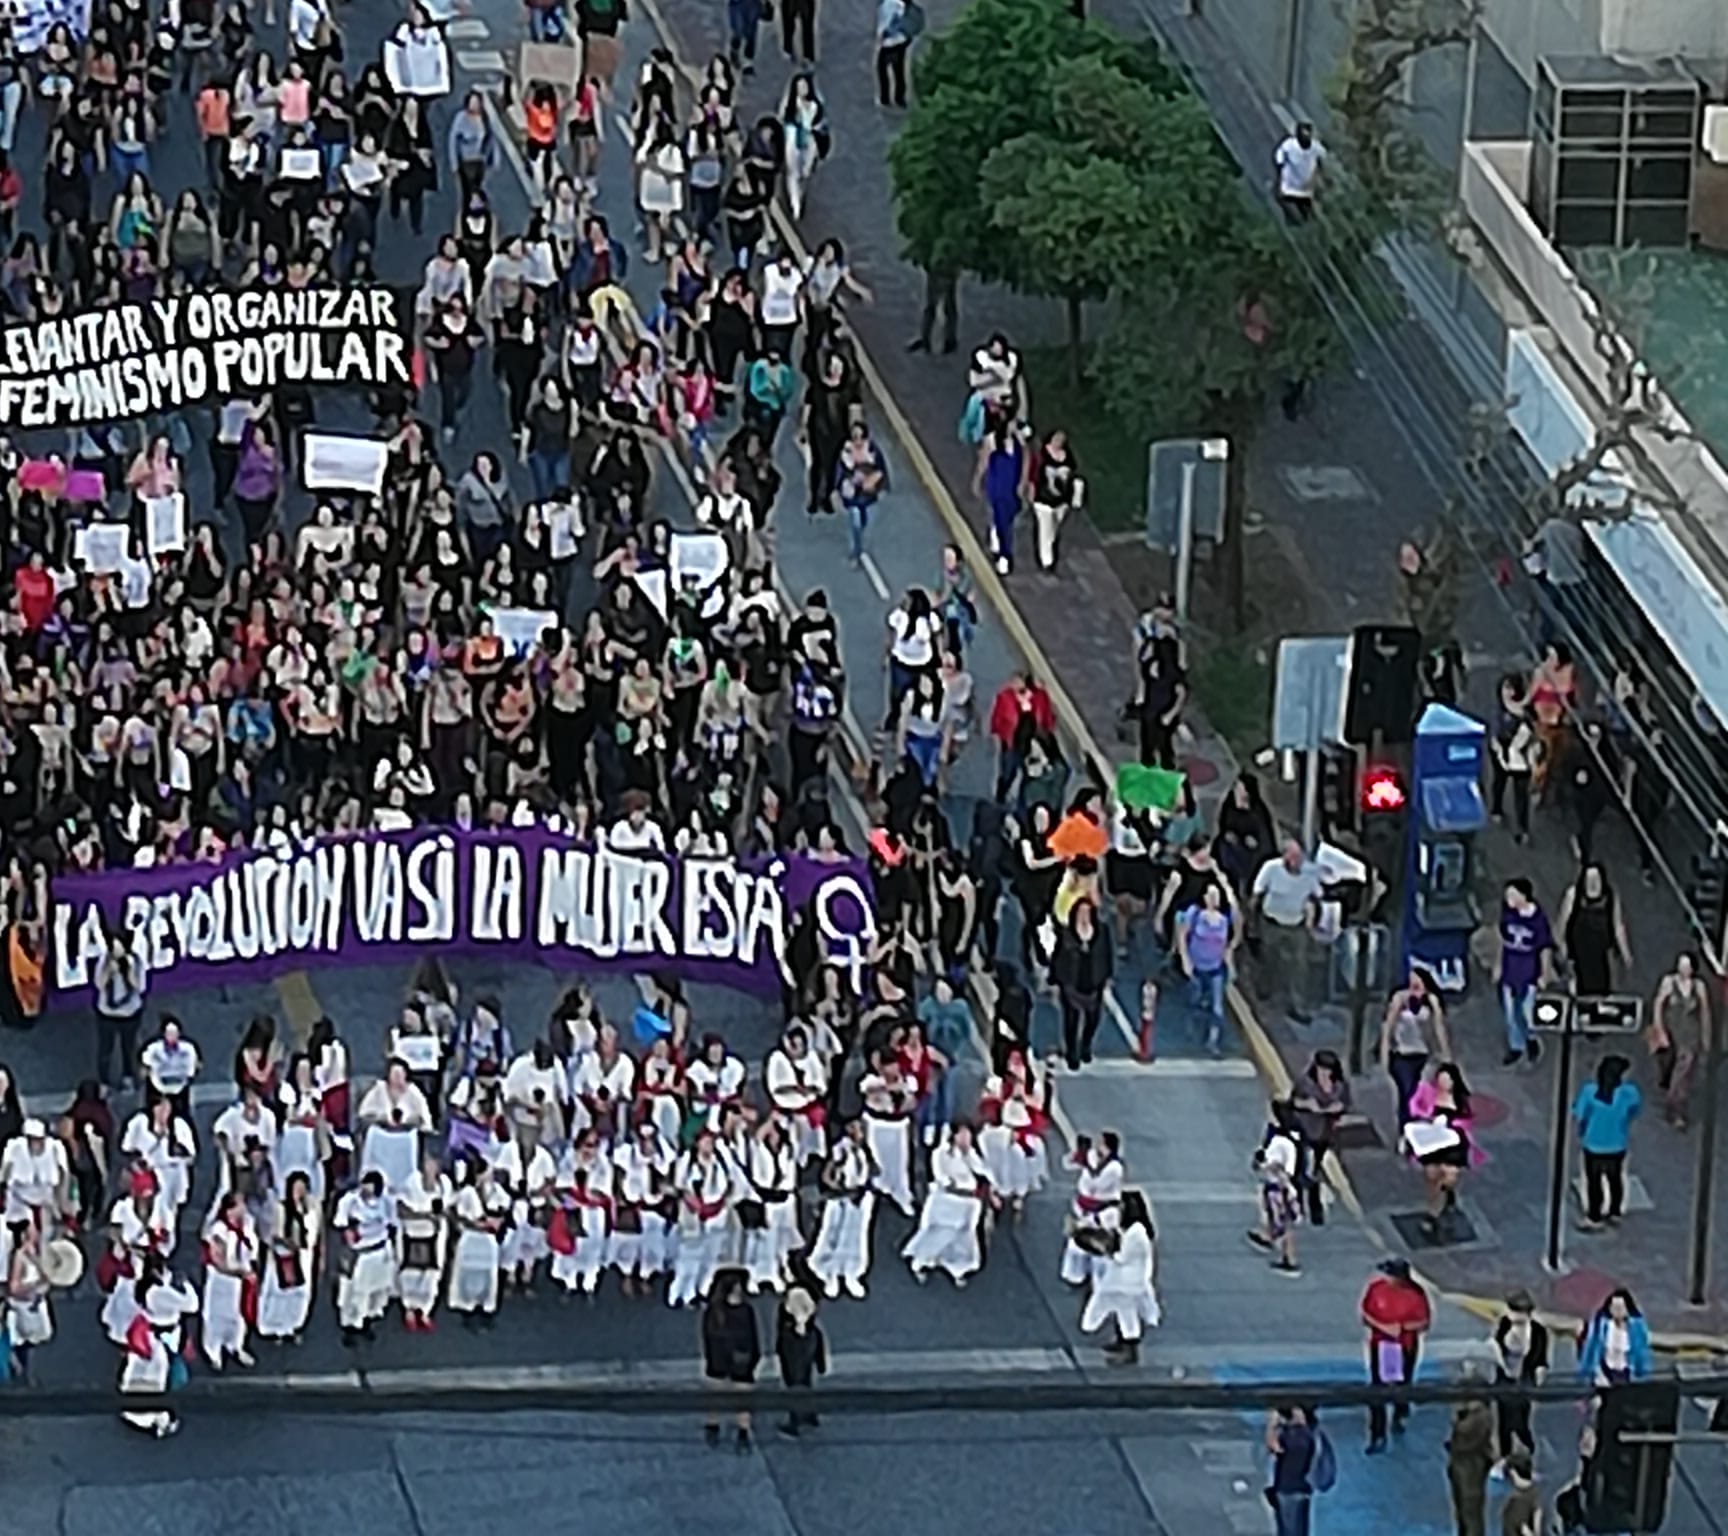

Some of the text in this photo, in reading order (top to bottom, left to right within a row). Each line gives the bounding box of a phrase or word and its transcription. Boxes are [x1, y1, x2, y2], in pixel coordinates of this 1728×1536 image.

[152, 298, 179, 345] Y
[187, 289, 398, 340] ORGANIZAR
[213, 329, 410, 394] POPULAR
[54, 902, 108, 989] LA
[472, 845, 521, 940] LA
[538, 846, 677, 959] MUJER
